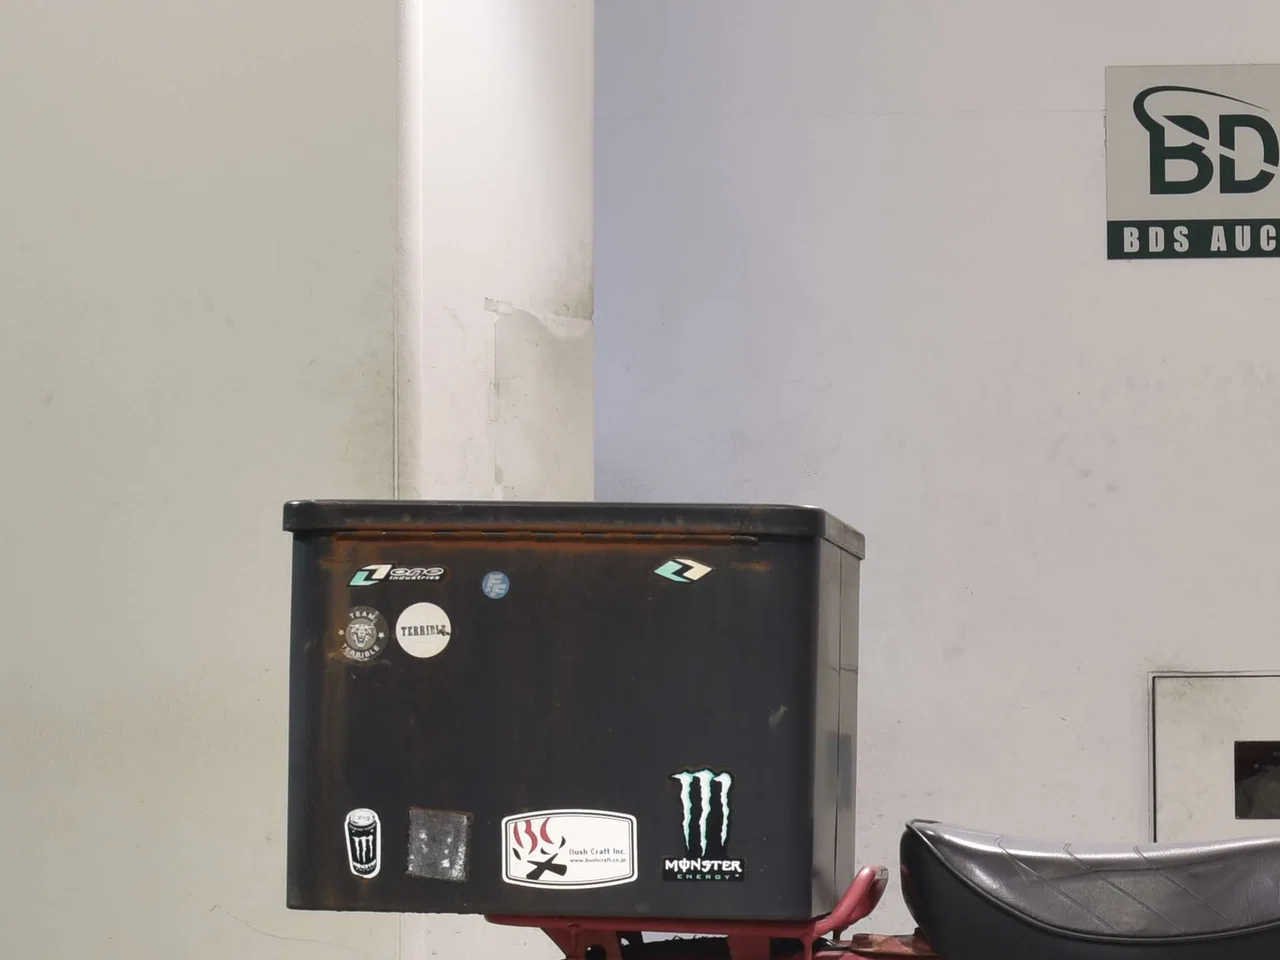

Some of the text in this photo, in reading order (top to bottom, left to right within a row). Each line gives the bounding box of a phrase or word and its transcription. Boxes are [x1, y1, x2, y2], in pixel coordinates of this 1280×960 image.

[1123, 226, 1190, 253] BDS
[350, 610, 375, 623] TEAM
[590, 847, 610, 855] Craft
[665, 857, 742, 873] MONSTER
